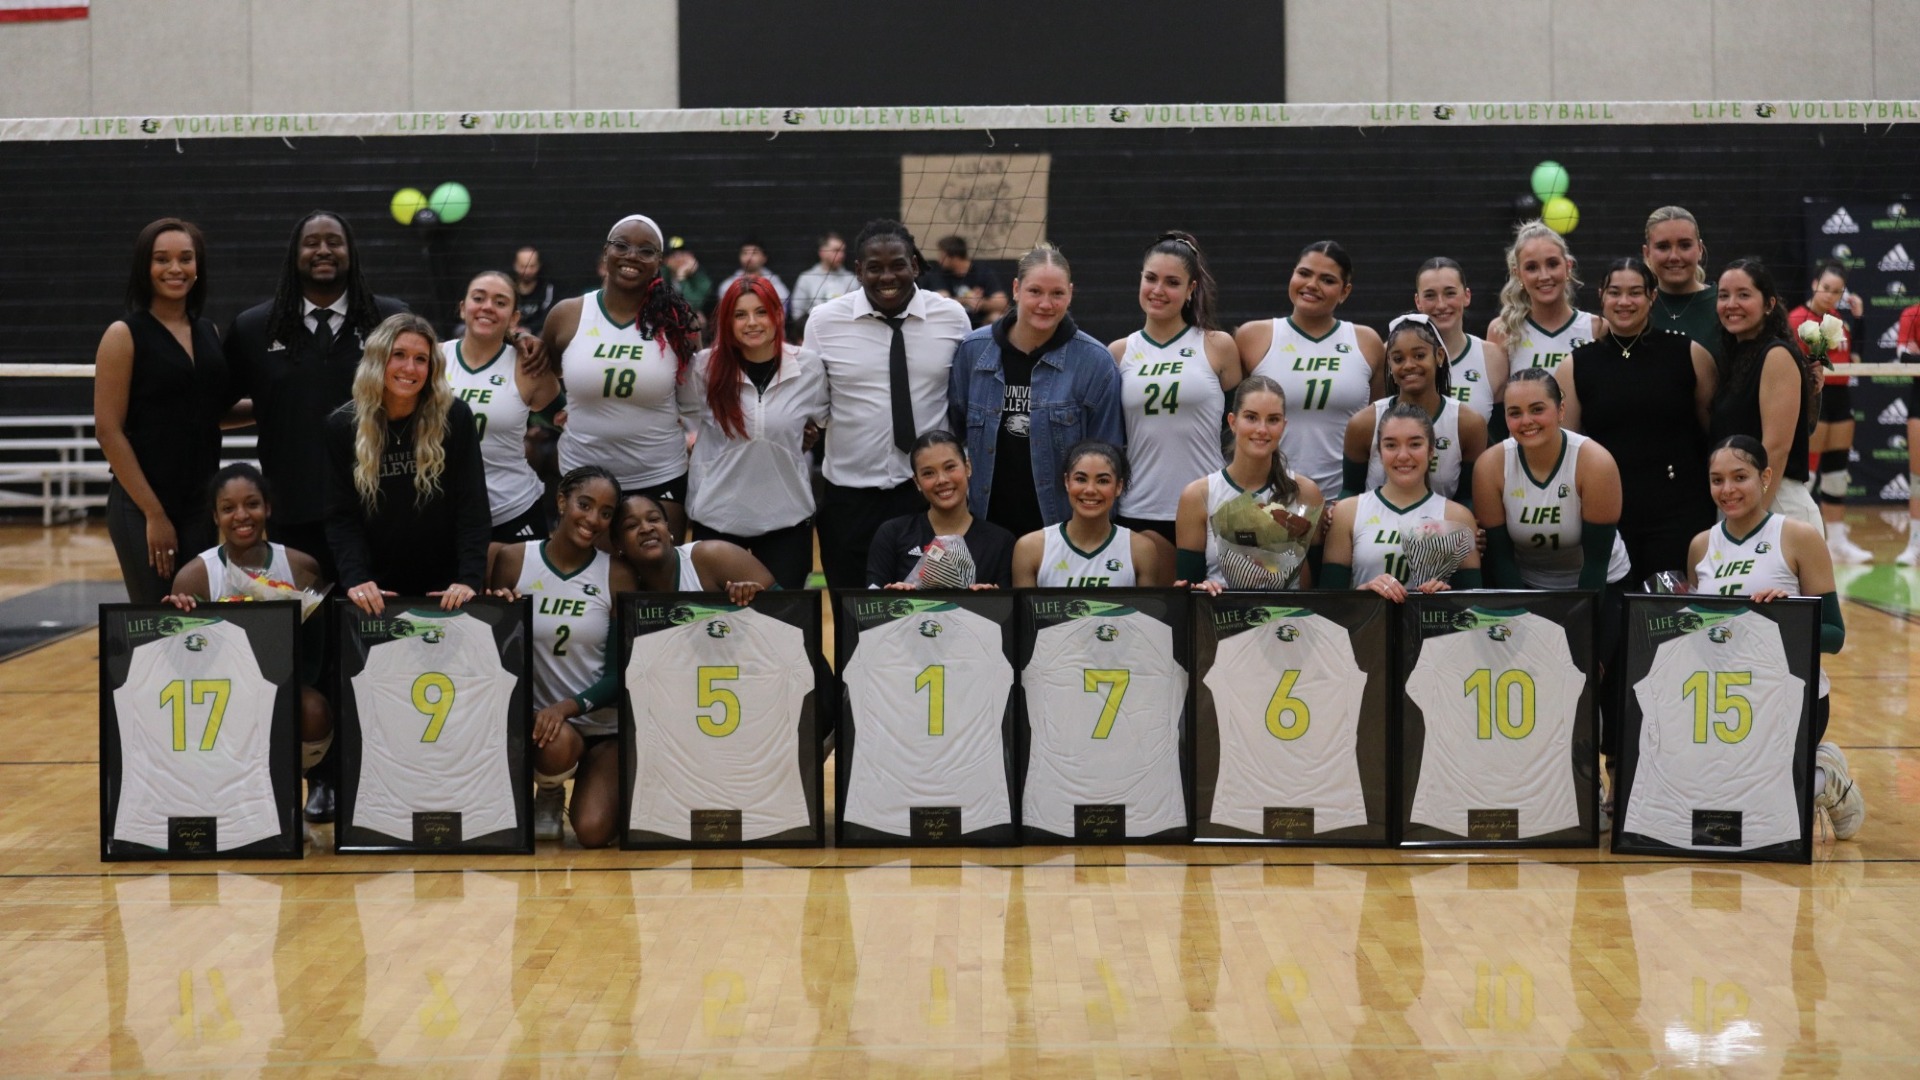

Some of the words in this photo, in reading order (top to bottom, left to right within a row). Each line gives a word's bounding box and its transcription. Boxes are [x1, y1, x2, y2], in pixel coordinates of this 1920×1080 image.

[720, 109, 769, 125] LIFE
[818, 107, 964, 124] VOLLEYBALL
[1046, 106, 1095, 123] LIFE
[1144, 105, 1290, 122] VOLLEYBALL
[1370, 105, 1419, 120] LIFE
[1468, 104, 1613, 119] VOLLEYBALL
[1692, 103, 1741, 118] LIFE
[1789, 102, 1920, 118] VOLLEYBAL
[79, 119, 127, 135] LIFE
[174, 116, 318, 132] VOLLEYBALL
[397, 114, 446, 130] LIFE
[494, 112, 639, 128] VOLLEYBALL
[593, 343, 643, 361] LIFE
[1531, 353, 1569, 368] LIF
[1138, 362, 1183, 377] LIFE
[1292, 357, 1340, 371] LIFE
[602, 367, 637, 398] 18
[451, 388, 492, 404] IFE
[1143, 381, 1179, 415] 24
[1302, 378, 1332, 410] 11
[1450, 387, 1470, 402] FE
[381, 451, 411, 464] UNIVE
[1520, 506, 1561, 523] LIFE
[1374, 529, 1401, 544] LI
[1531, 533, 1559, 551] 21
[1714, 559, 1755, 579] LIFE
[539, 597, 586, 616] LIFE
[639, 606, 665, 619] LIFE
[858, 601, 884, 615] LIFE
[1035, 601, 1061, 613] LIFE
[128, 618, 154, 632] LIFE
[361, 619, 386, 632] LIFE
[1215, 610, 1241, 624] LIFE
[1422, 611, 1448, 622] LIFE
[1649, 615, 1675, 630] LIFE
[553, 624, 571, 656] 2
[411, 672, 456, 742] 9
[696, 666, 741, 737] 5
[915, 665, 944, 736] 1
[1084, 669, 1130, 739] 7
[1265, 670, 1310, 741] 6
[1464, 669, 1536, 740] 10
[1683, 671, 1753, 744] 15
[160, 679, 231, 751] 17
